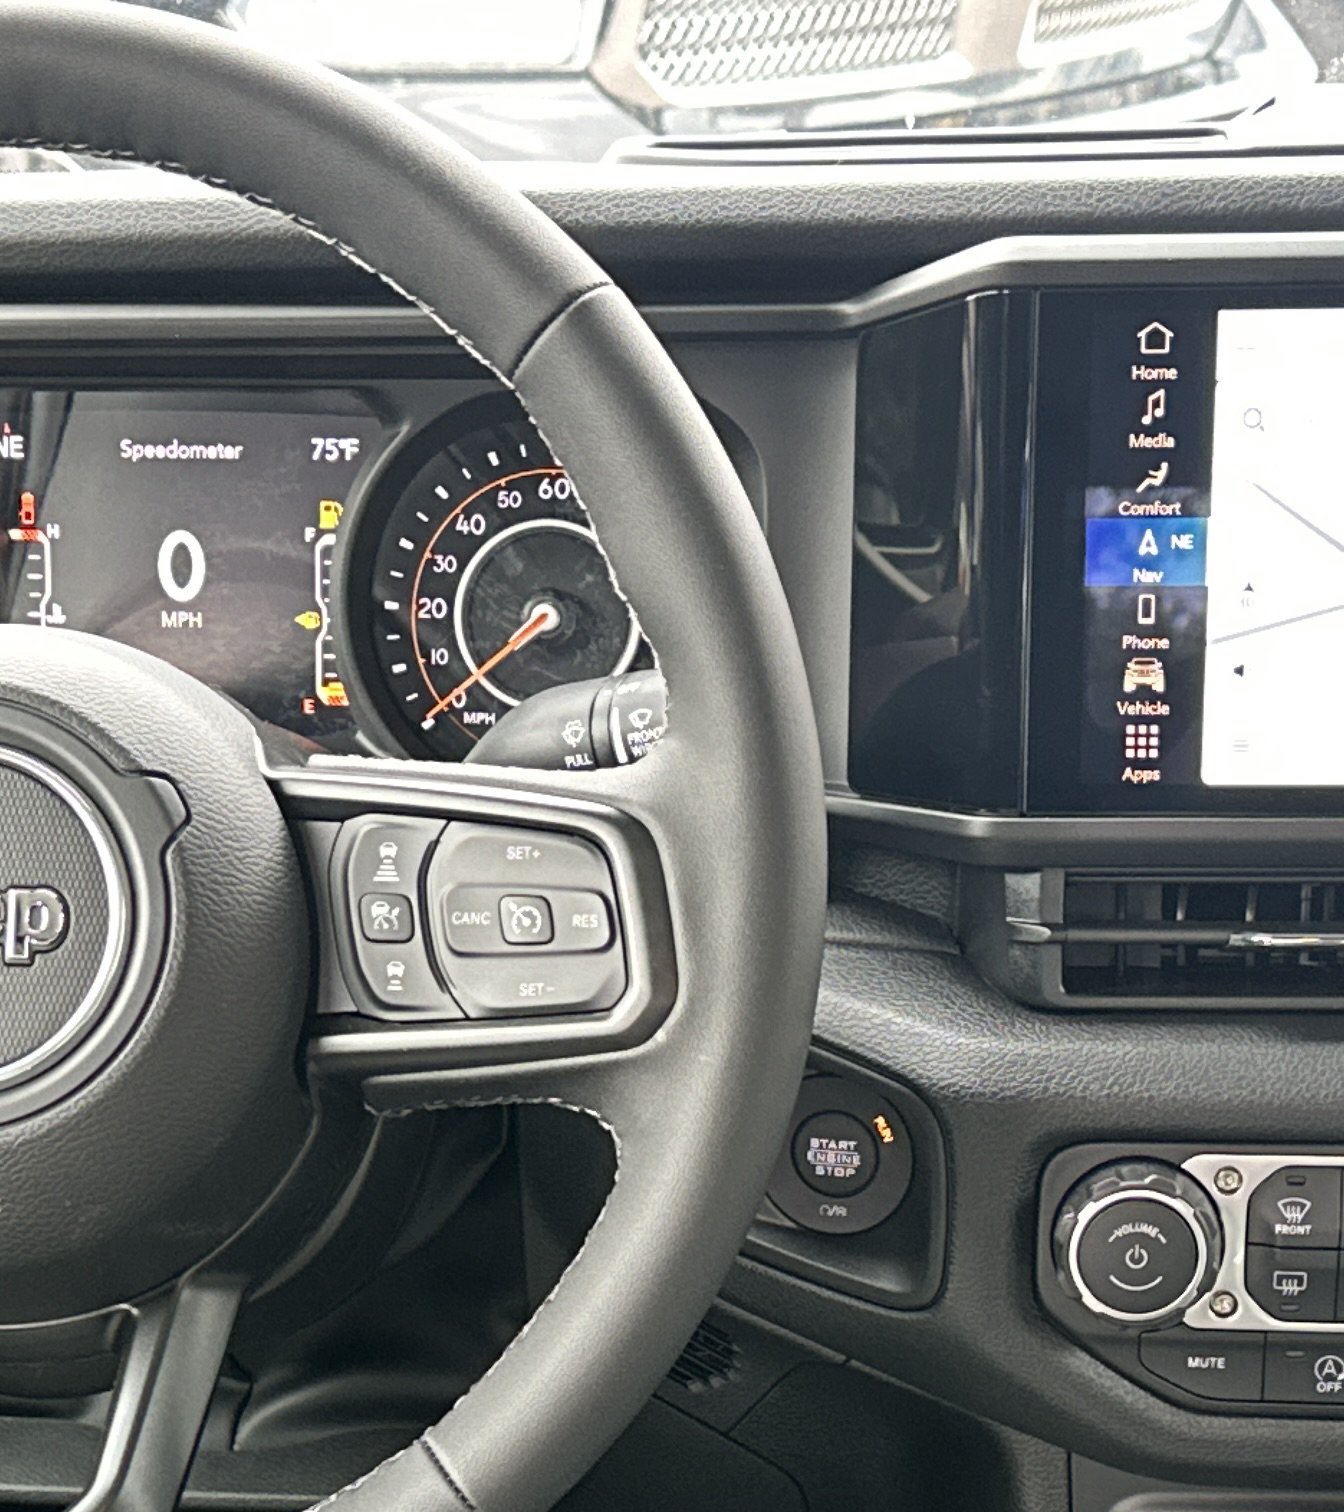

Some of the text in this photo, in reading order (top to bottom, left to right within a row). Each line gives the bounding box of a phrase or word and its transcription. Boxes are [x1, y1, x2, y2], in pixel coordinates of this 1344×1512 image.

[1131, 364, 1178, 381] Home
[1128, 433, 1175, 449] Media
[119, 439, 244, 462] Speedometer
[537, 477, 570, 499] 60
[497, 490, 522, 509] 50
[1118, 501, 1181, 517] Comfort
[46, 523, 60, 539] H
[455, 513, 486, 536] 40
[304, 527, 316, 543] F
[1171, 534, 1195, 550] NE
[157, 529, 206, 602] 0
[433, 554, 457, 573] 30
[1132, 567, 1164, 583] Nav
[417, 597, 448, 620] 20
[160, 611, 203, 629] MPH
[1121, 635, 1170, 652] Phone
[429, 648, 449, 667] 10
[302, 699, 315, 714] E
[1116, 701, 1170, 716] Vehicle
[462, 711, 496, 726] MPH
[564, 752, 594, 769] PULL
[1121, 766, 1162, 784] Apps
[451, 911, 492, 926] CANC
[571, 913, 599, 928] RES
[809, 1137, 858, 1151] START
[806, 1150, 862, 1166] ENGINE
[814, 1165, 856, 1178] STOP
[1113, 1221, 1160, 1239] VOLUME
[1274, 1223, 1312, 1236] FRONT
[1186, 1356, 1226, 1370] MUTE
[1316, 1380, 1344, 1393] OFF
